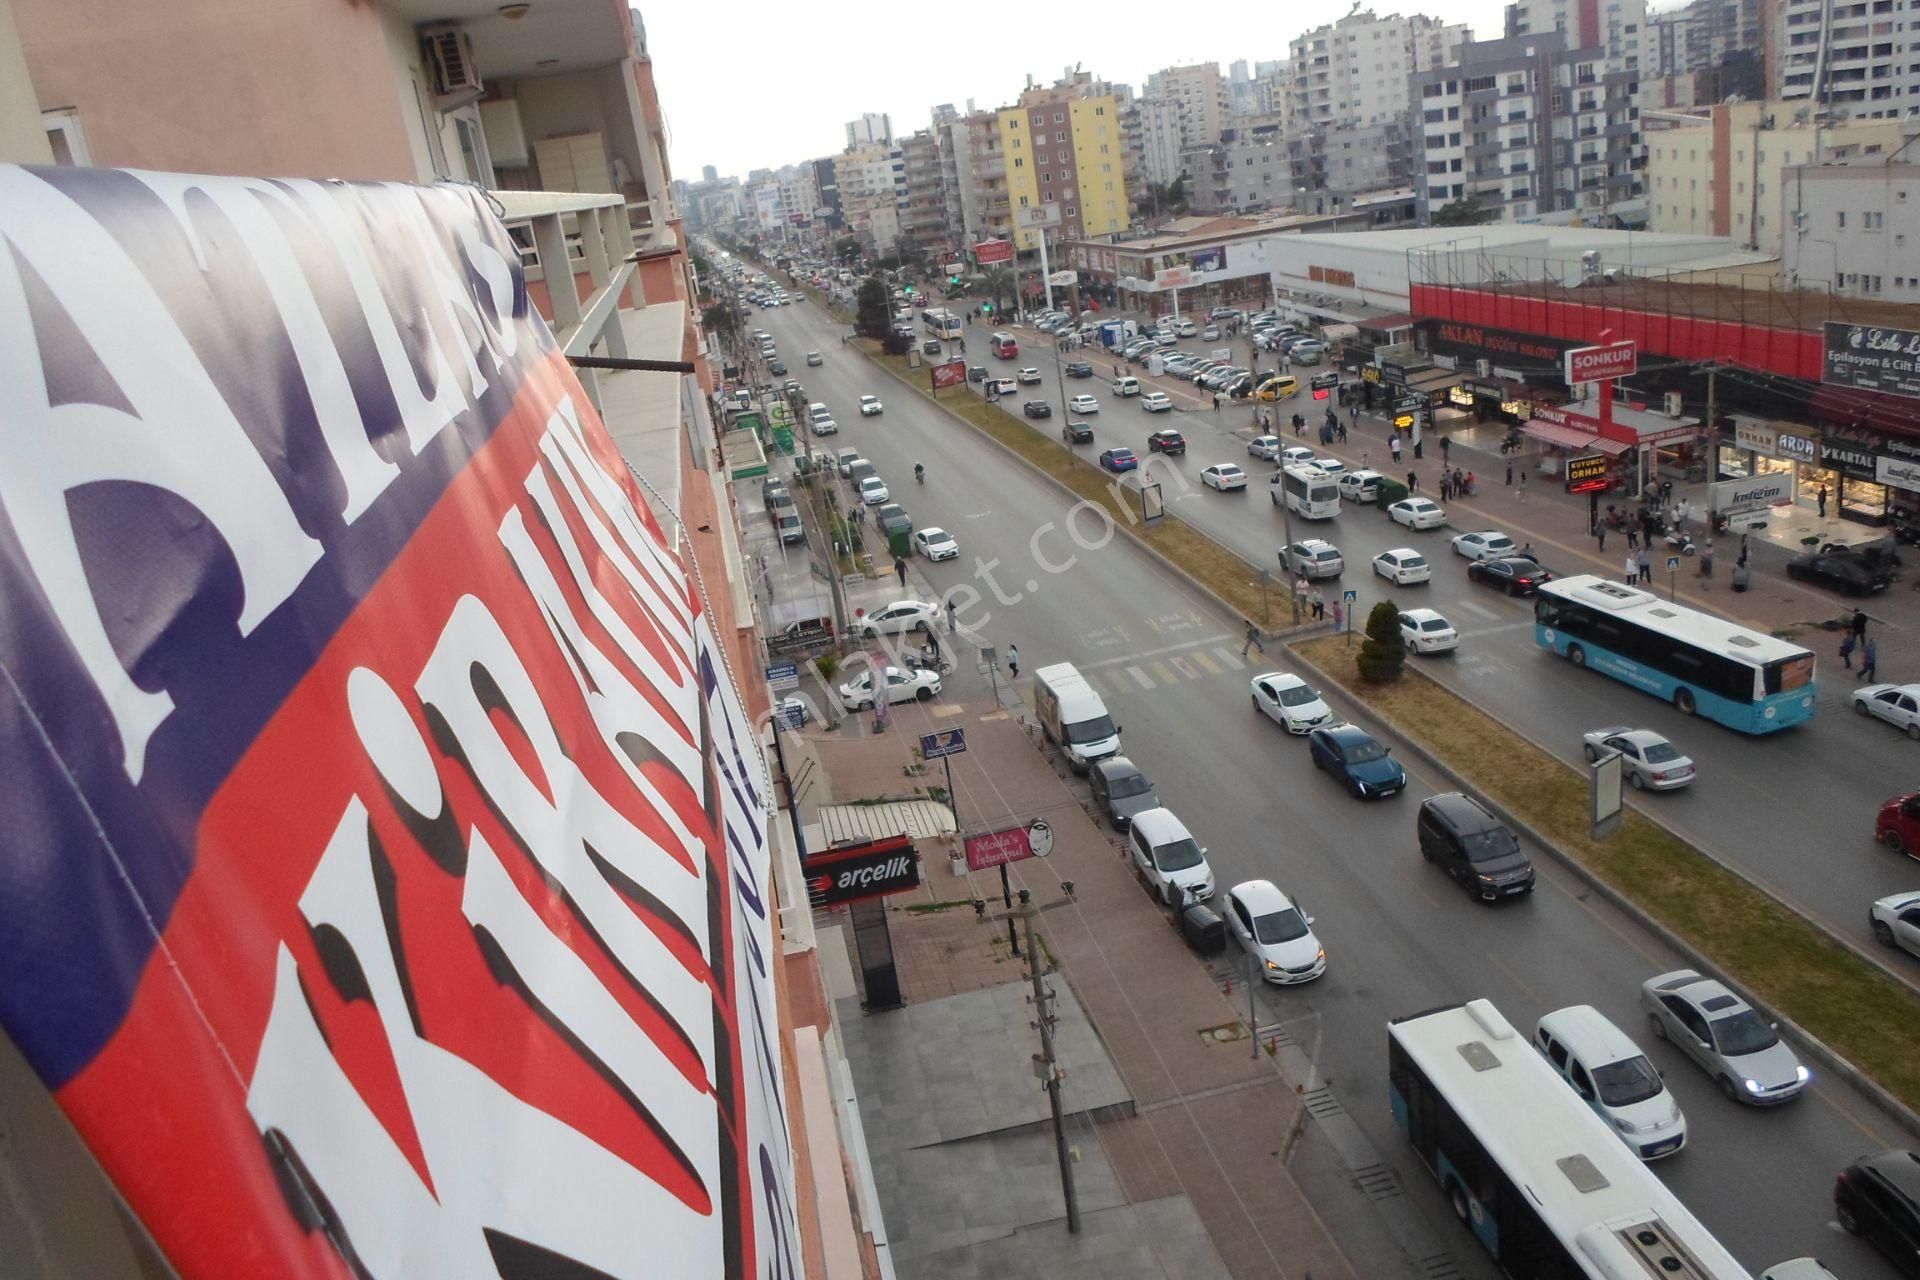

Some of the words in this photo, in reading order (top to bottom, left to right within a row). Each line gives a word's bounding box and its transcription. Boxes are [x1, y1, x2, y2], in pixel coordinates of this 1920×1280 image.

[1574, 349, 1632, 369] SONKUR
[1828, 350, 1880, 367] Epilasyon
[1881, 357, 1891, 368] &
[1893, 359, 1914, 371] Cilt
[1534, 406, 1568, 425] SONKUR
[1737, 429, 1772, 446] ORHAN
[1778, 433, 1815, 456] ARDA
[1831, 447, 1874, 468] KARTAL
[1571, 467, 1607, 479] ORHAN
[838, 856, 910, 888] arçelik
